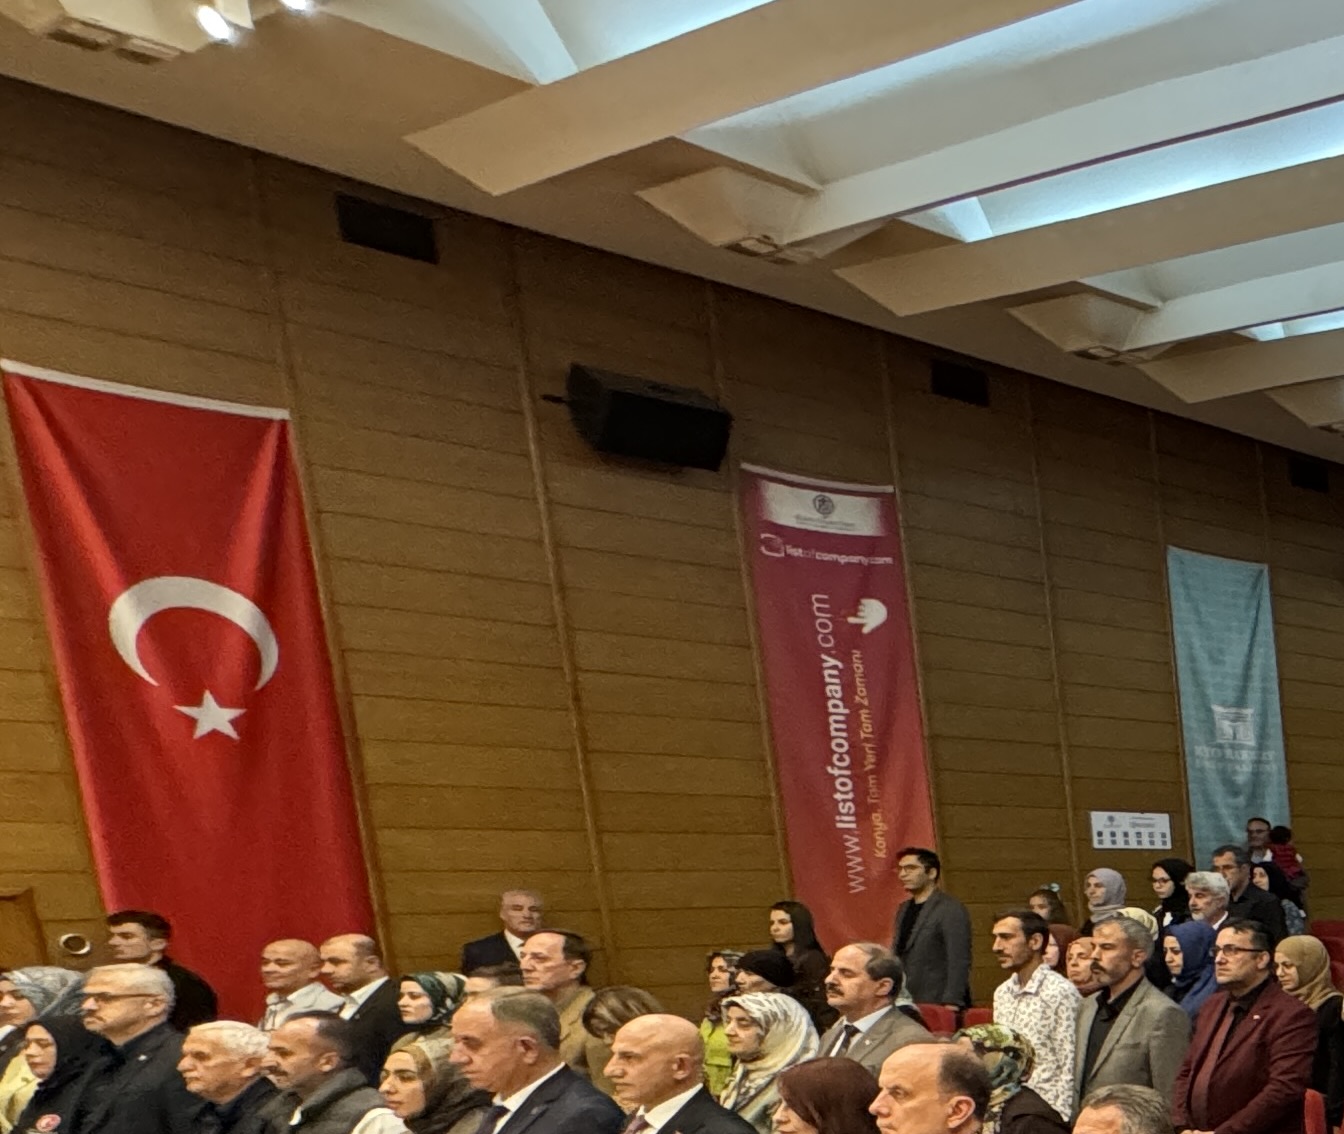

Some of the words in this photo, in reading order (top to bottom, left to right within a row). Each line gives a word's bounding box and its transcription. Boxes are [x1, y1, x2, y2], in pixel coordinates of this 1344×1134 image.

[811, 593, 867, 894] www.listofcompany.com
[859, 708, 874, 740] Tam
[868, 775, 881, 804] Tam
[871, 808, 888, 859] Konya,
